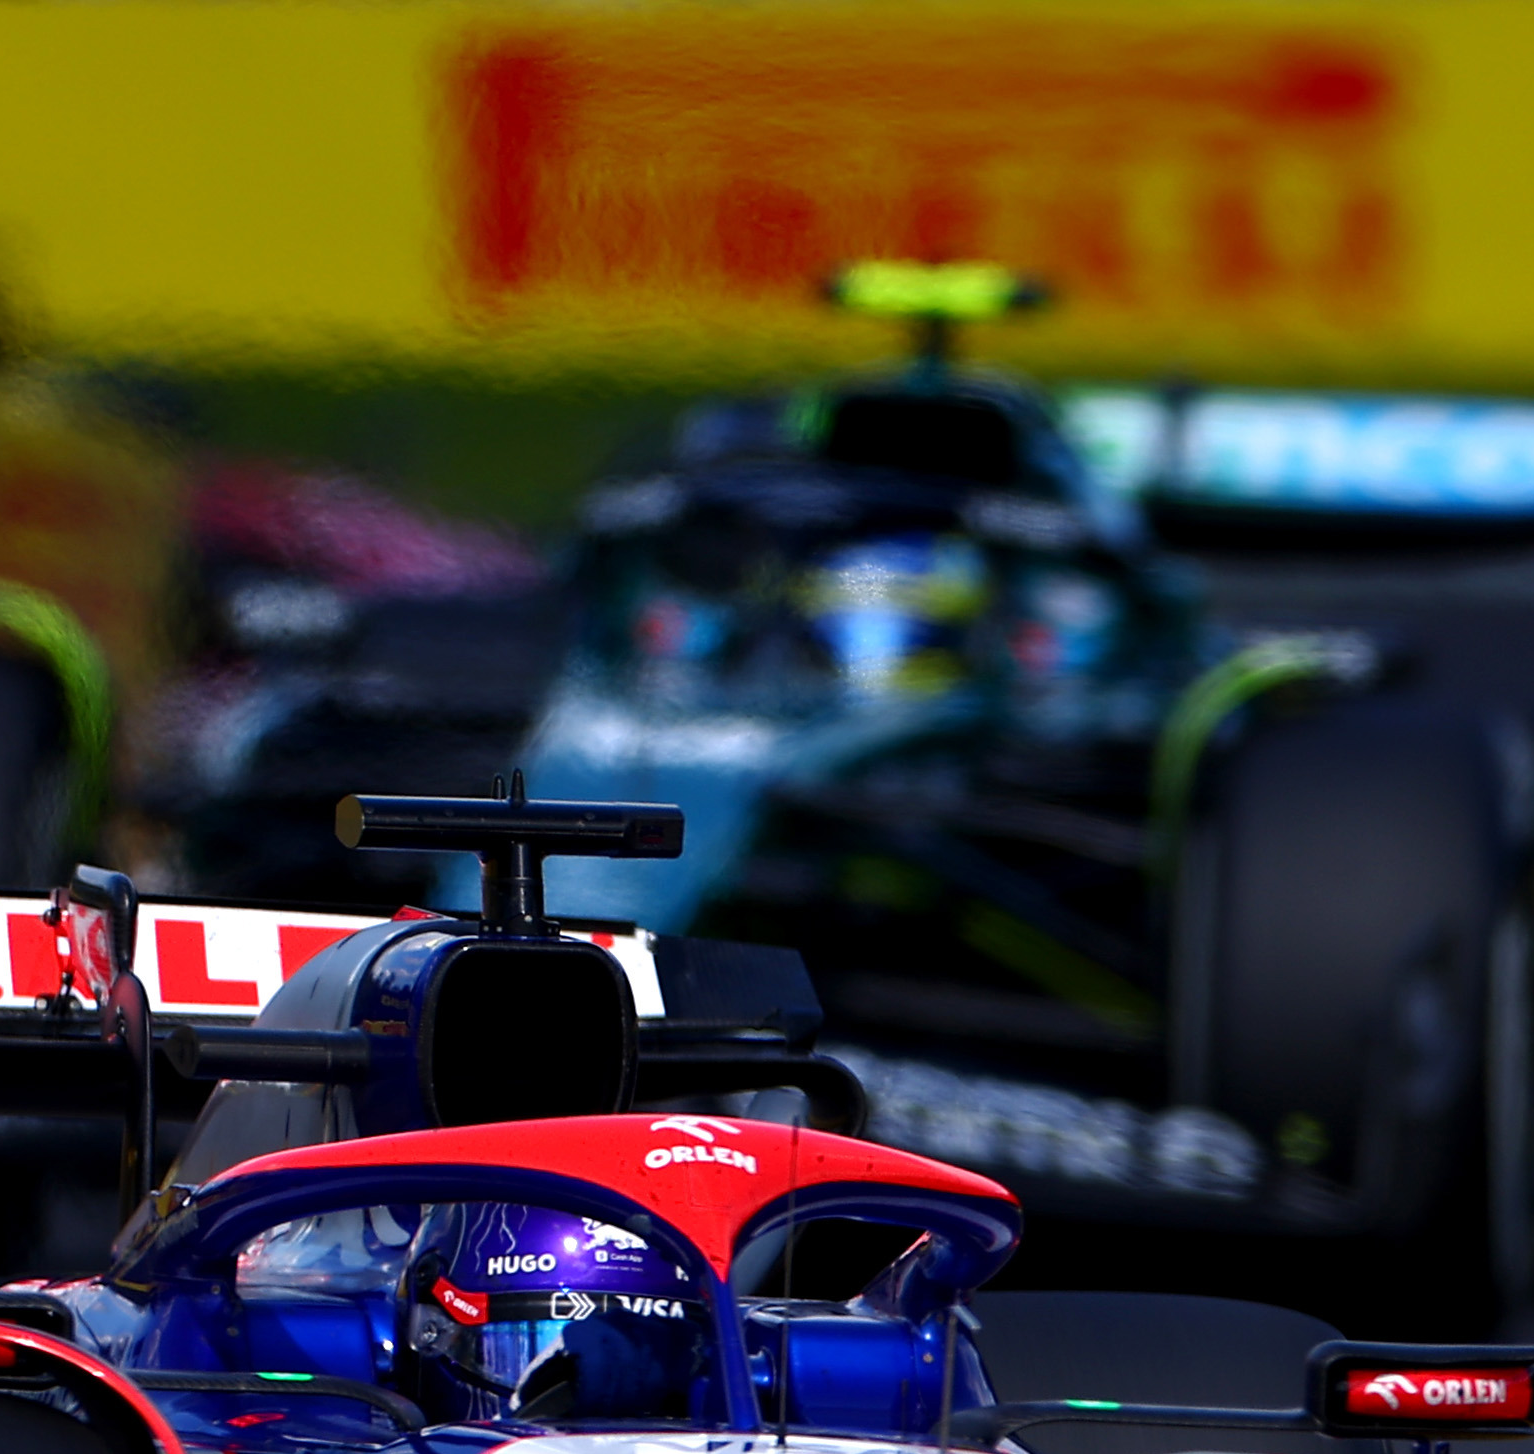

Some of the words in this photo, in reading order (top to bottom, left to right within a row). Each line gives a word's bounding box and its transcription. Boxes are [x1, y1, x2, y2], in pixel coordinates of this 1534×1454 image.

[644, 1145, 756, 1174] ORLEN
[487, 1253, 556, 1276] HUGO
[1422, 1378, 1507, 1405] ORLEN
